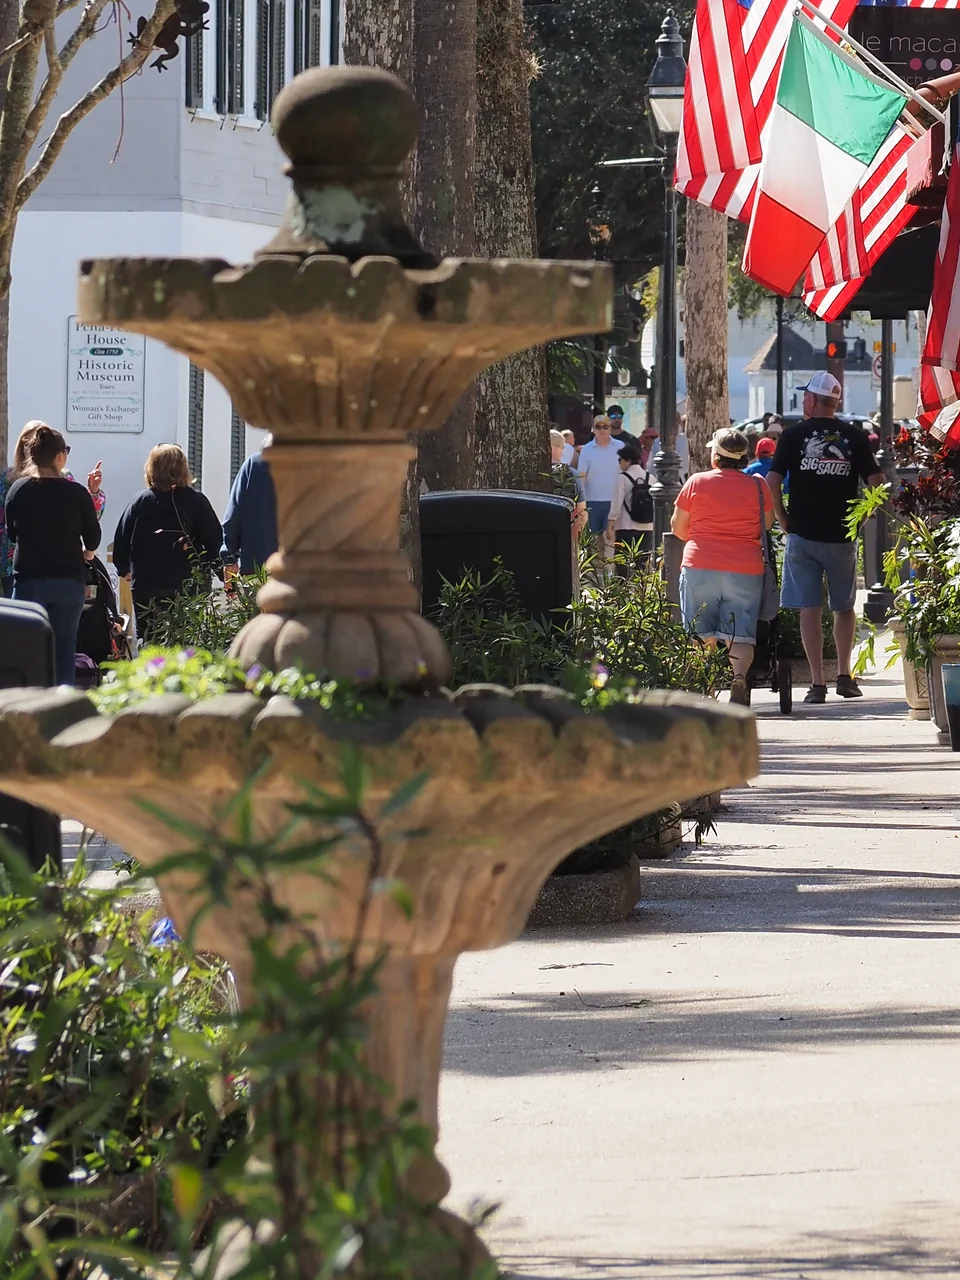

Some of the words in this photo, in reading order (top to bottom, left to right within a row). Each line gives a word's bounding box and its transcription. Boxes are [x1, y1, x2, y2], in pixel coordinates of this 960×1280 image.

[87, 334, 127, 345] House
[79, 360, 134, 370] Historic
[76, 371, 135, 382] Museum
[106, 405, 139, 414] Exchange
[104, 413, 123, 422] Shop
[800, 457, 820, 471] SIG
[816, 462, 852, 477] SAUER
